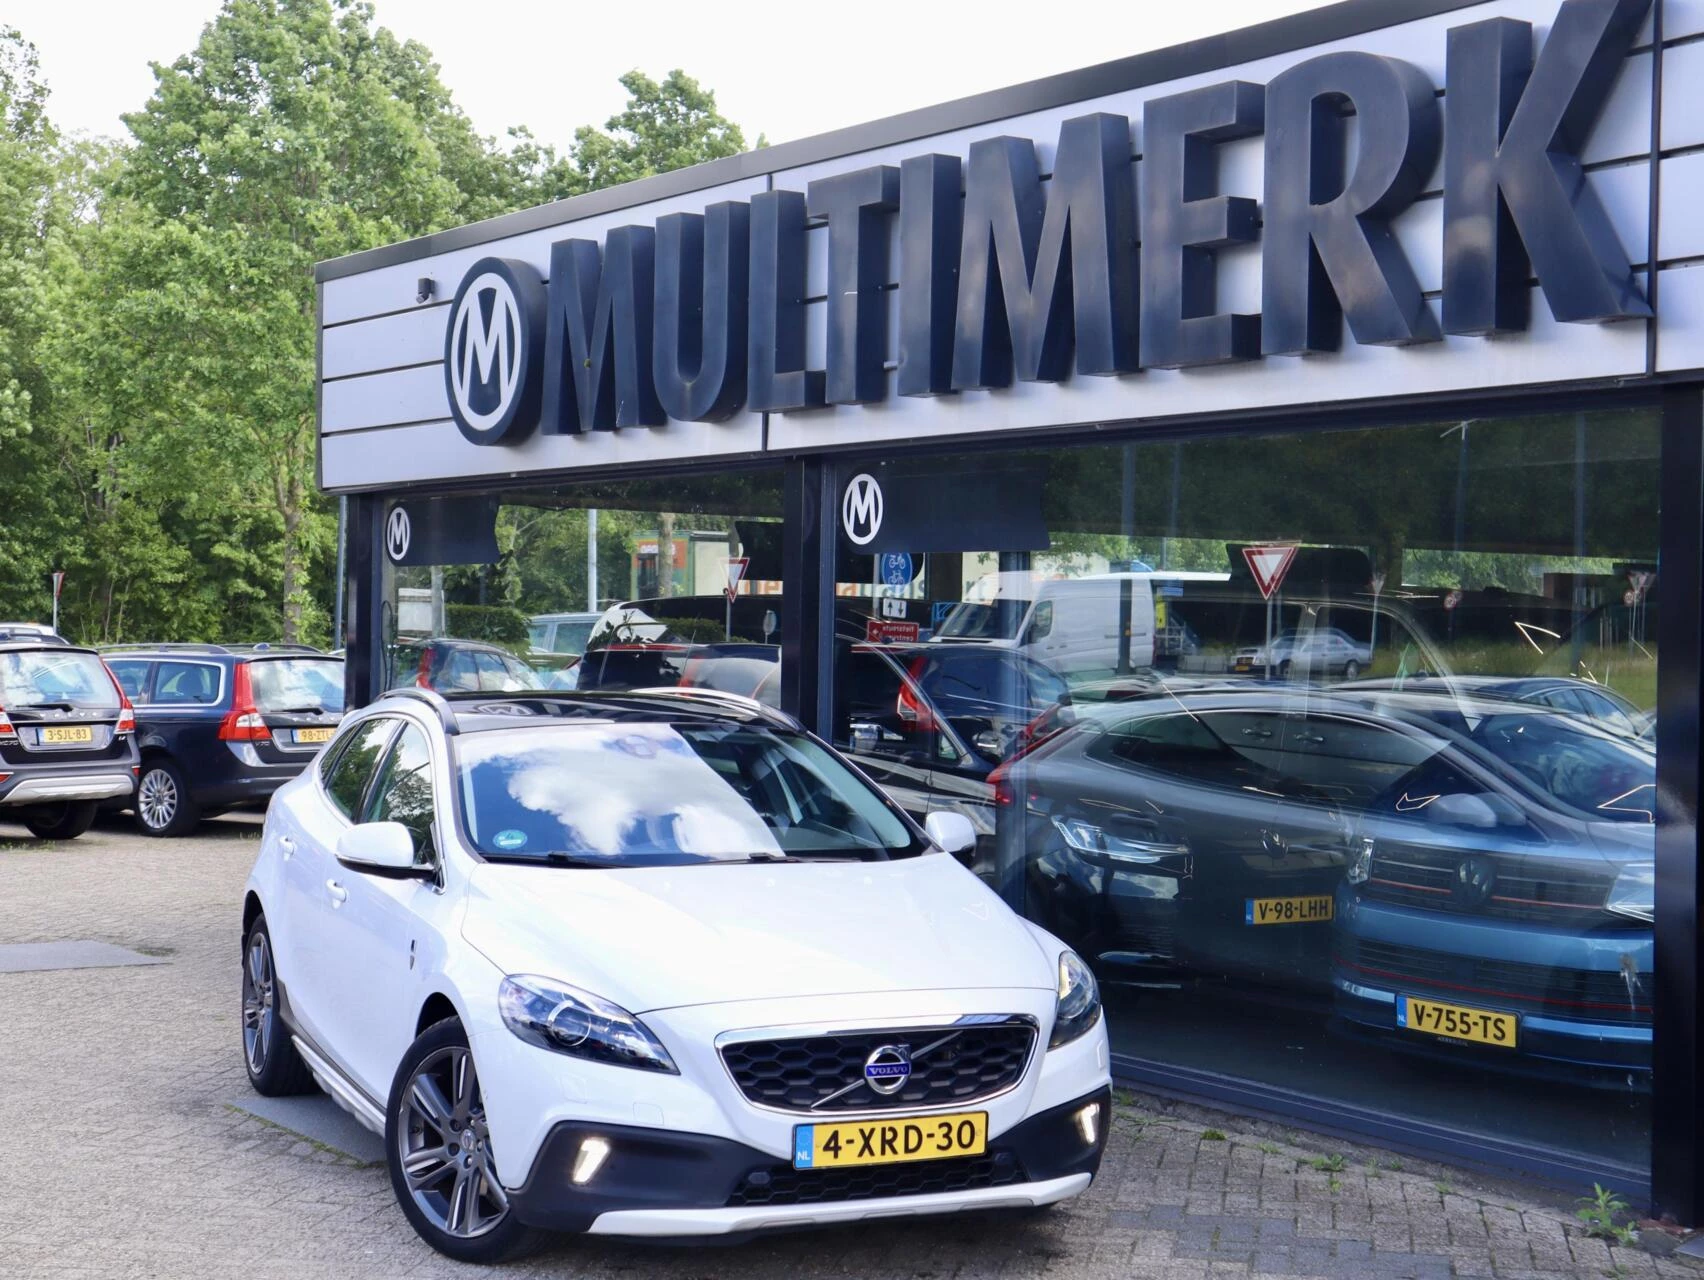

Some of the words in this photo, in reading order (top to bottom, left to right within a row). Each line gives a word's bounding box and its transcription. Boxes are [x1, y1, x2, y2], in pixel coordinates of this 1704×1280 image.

[541, 0, 1653, 436] MULTIMERK
[48, 728, 87, 740] 3-SJL-83
[1258, 900, 1328, 920] V-98-LHH
[1413, 1003, 1506, 1041] V-755-TS
[868, 1065, 908, 1075] VOLVO
[822, 1119, 976, 1159] 4-XRD-30
[797, 1151, 811, 1161] NL
